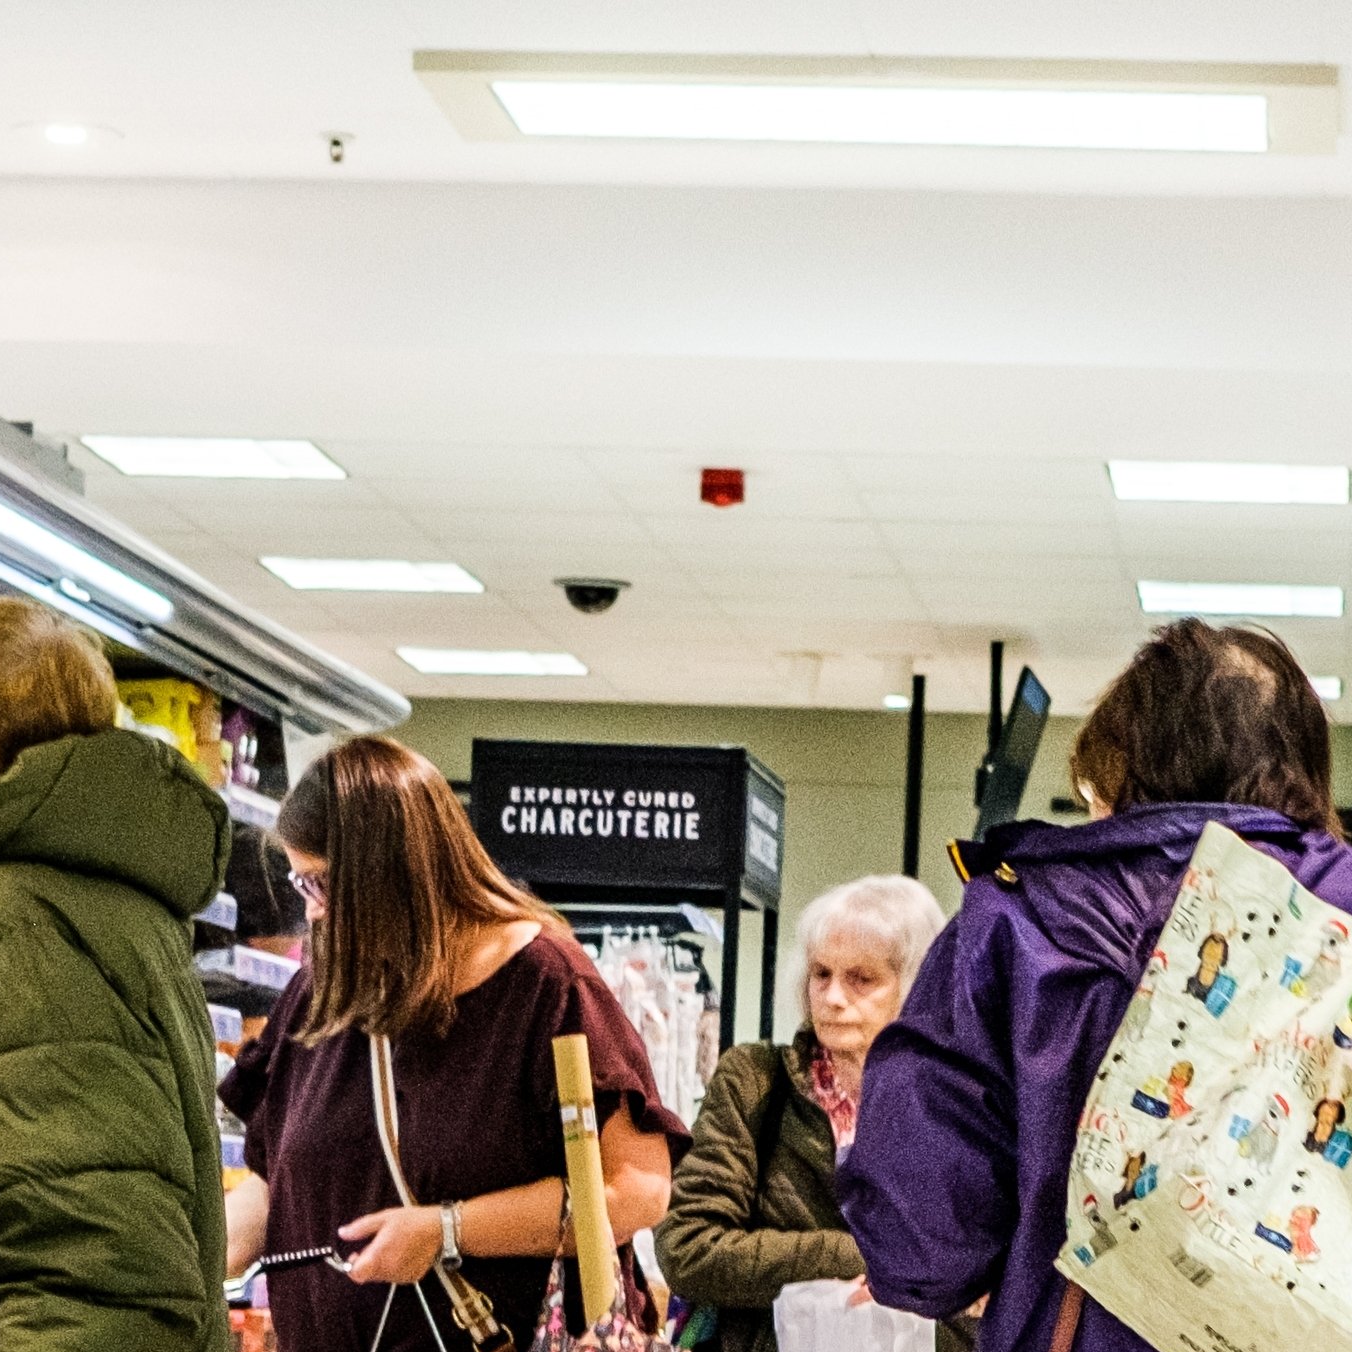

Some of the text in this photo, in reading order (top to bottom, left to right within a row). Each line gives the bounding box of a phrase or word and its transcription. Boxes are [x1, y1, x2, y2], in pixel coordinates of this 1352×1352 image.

[509, 785, 696, 809] EXPERTLY CURED
[500, 805, 700, 840] CHARCUTERIE
